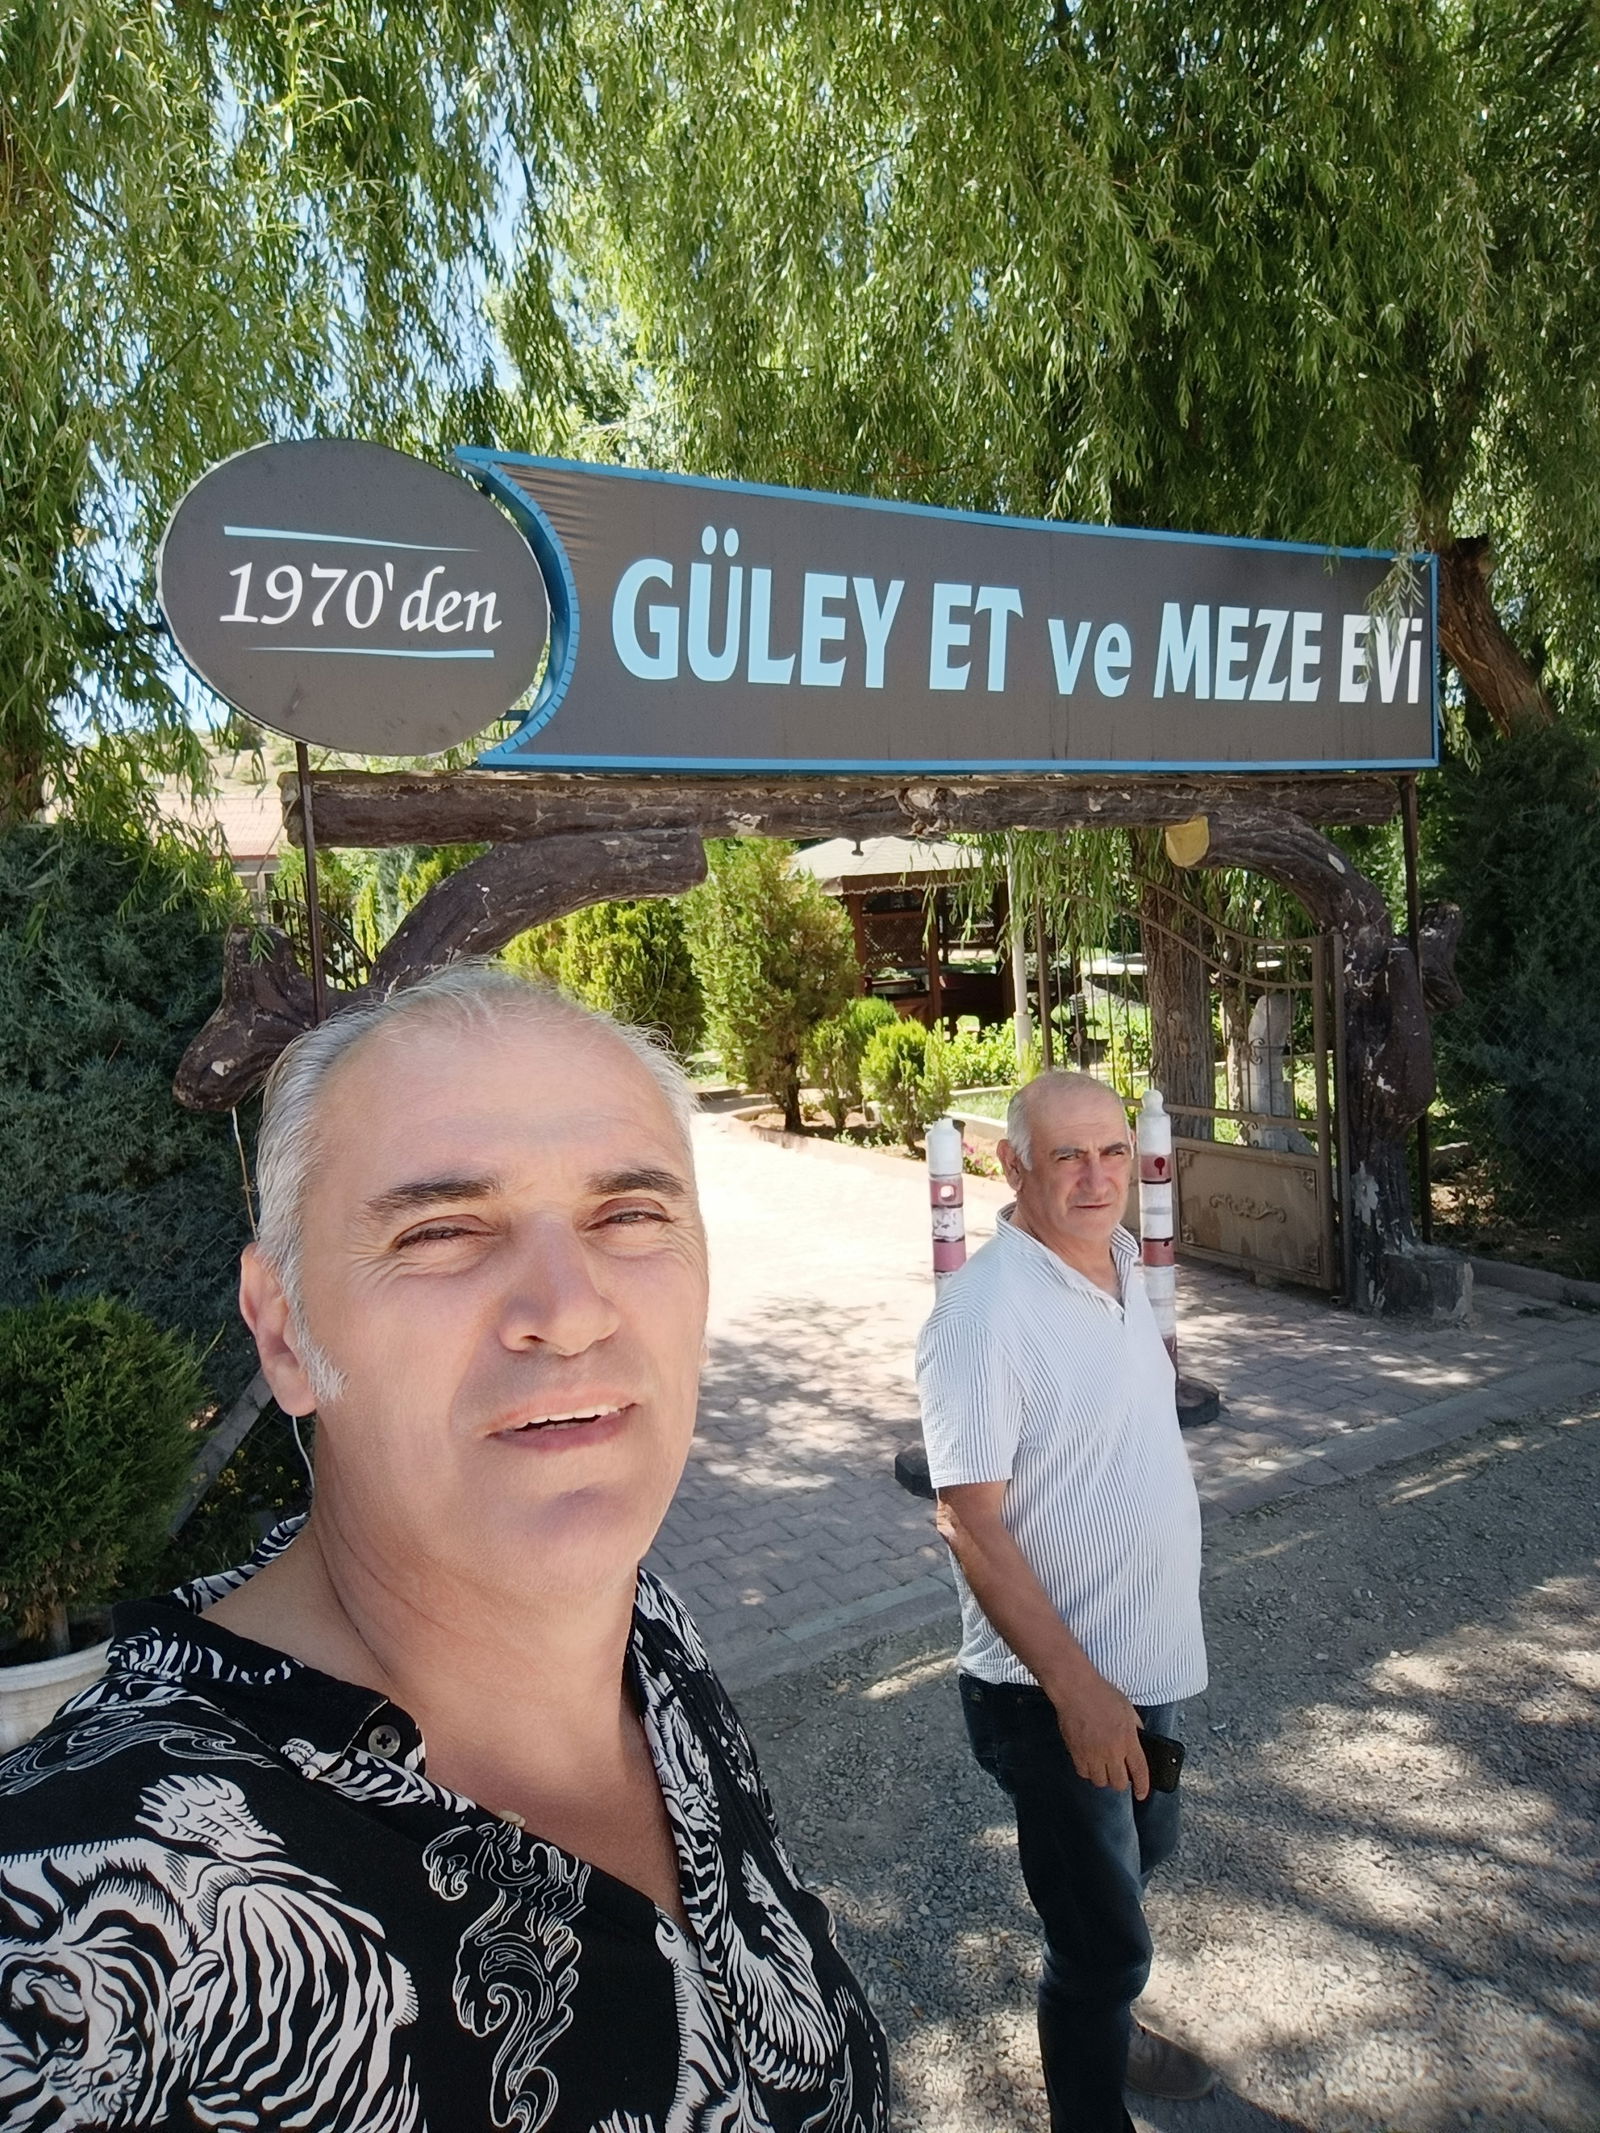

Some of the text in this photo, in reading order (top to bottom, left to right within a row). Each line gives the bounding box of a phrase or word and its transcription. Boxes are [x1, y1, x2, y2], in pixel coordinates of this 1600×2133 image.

[218, 561, 503, 635] 1970'den
[612, 525, 905, 690] GÜLEY
[929, 582, 1024, 693] ET
[1047, 618, 1133, 698] ve
[1153, 602, 1323, 703] MEZE
